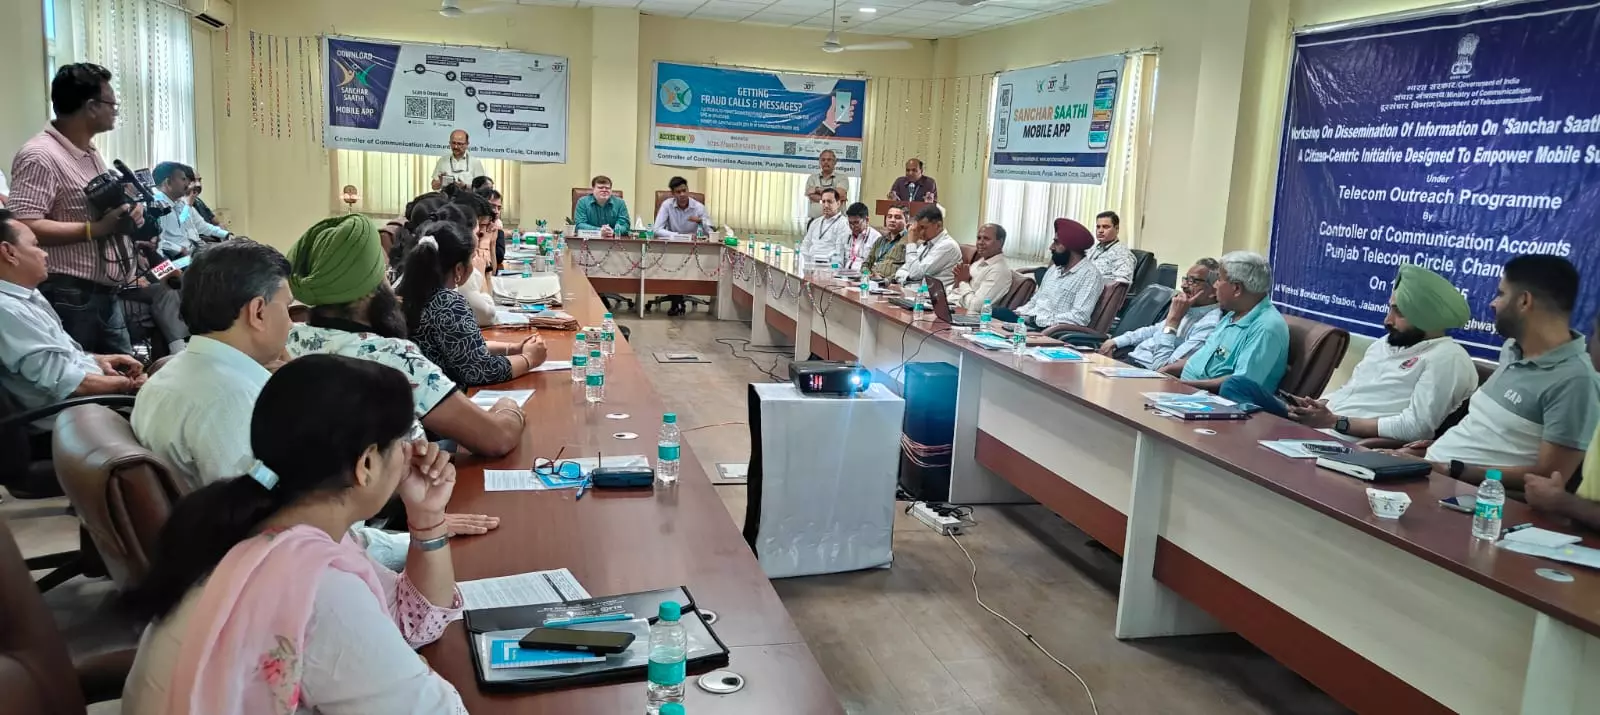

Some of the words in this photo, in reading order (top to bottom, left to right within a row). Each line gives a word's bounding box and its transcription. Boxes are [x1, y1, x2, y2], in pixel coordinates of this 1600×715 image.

[1503, 77, 1520, 86] India
[737, 87, 769, 98] GETTING
[1479, 87, 1532, 97] Communications
[701, 94, 727, 106] FRAUD
[728, 96, 751, 108] CALLS
[759, 100, 803, 112] MESSAGES?
[1480, 95, 1542, 106] Telecommunications
[335, 105, 360, 115] MOBILE
[361, 108, 374, 117] APP
[1013, 106, 1053, 122] SANCHAR
[1054, 103, 1088, 120] SAATHI
[1022, 124, 1053, 139] MOBILE
[1053, 123, 1071, 137] APP
[1321, 124, 1334, 138] On
[1334, 122, 1399, 139] Dissemination
[1400, 121, 1415, 138] Of
[1414, 119, 1479, 138] Information
[1481, 118, 1499, 136] On
[1361, 146, 1403, 163] Initiative
[1404, 146, 1456, 168] Designed
[1457, 146, 1471, 164] To
[1472, 146, 1534, 168] Empower
[1534, 144, 1581, 164] Mobile
[1426, 173, 1450, 184] Under
[1338, 184, 1387, 202] Telecom
[1389, 186, 1455, 205] Outreach
[1458, 188, 1563, 212] Programme
[1422, 211, 1434, 222] By
[1319, 221, 1368, 240] Controller
[1370, 226, 1384, 240] of
[1385, 226, 1494, 252] Communication
[1496, 235, 1571, 257] Accounts
[1325, 243, 1360, 263] Punjab
[1362, 246, 1411, 266] Telecom
[1413, 251, 1457, 275] Circle,
[1369, 275, 1387, 292] On
[1358, 300, 1390, 314] Jalandh
[1503, 388, 1523, 405] GAP
